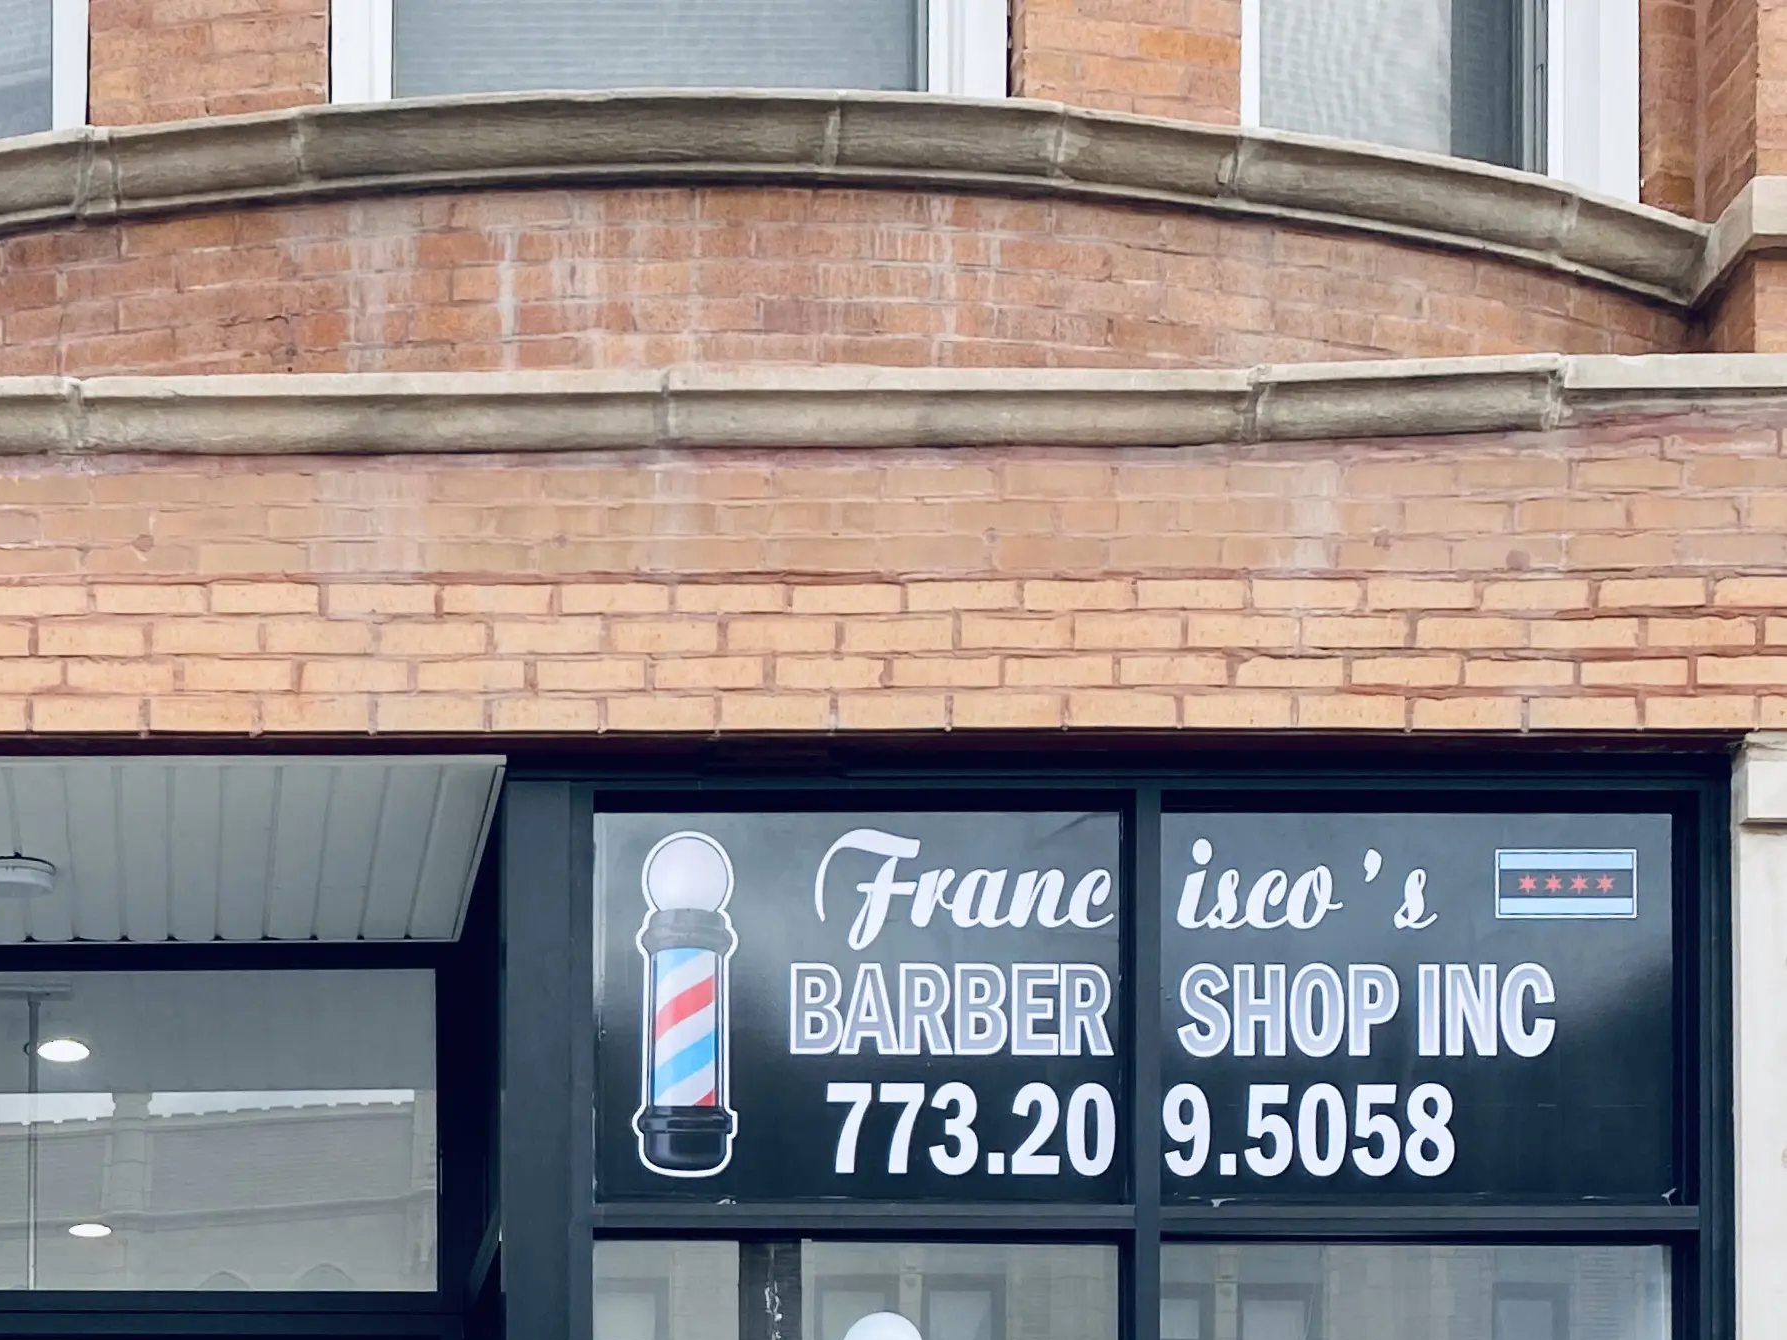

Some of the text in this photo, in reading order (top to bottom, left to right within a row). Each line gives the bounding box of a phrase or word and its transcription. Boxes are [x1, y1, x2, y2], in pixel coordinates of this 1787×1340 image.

[789, 962, 1556, 1058] BARBER SHOP INC
